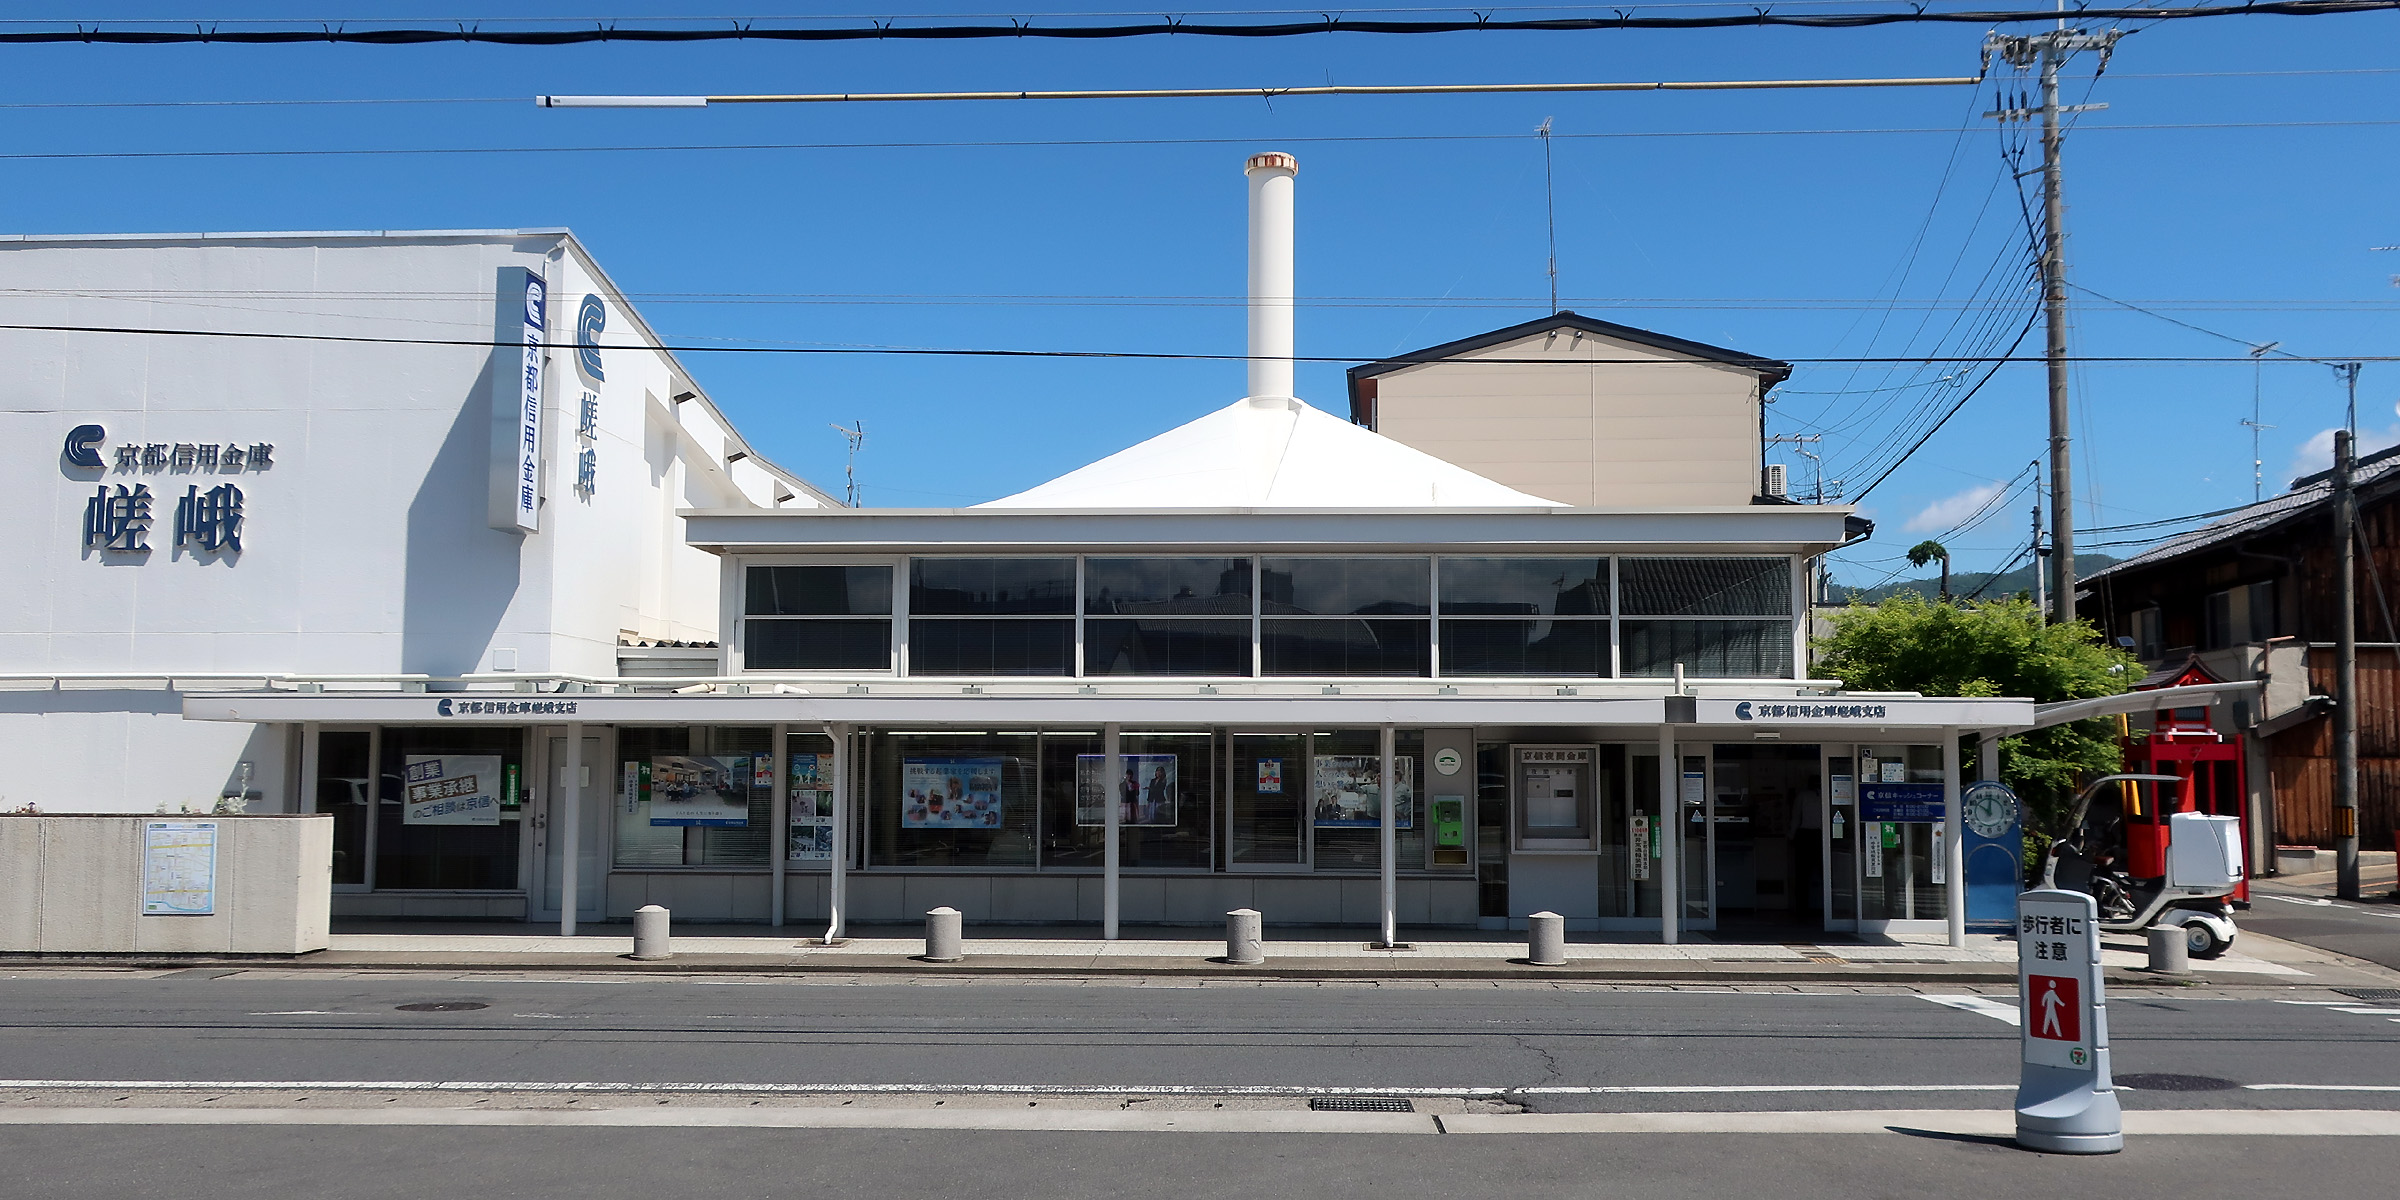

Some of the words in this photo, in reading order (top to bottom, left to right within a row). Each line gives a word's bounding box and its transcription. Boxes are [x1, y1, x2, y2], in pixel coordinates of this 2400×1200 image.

[519, 333, 539, 514] 京都信用金庫
[116, 442, 274, 467] 京都信用金庫
[579, 391, 598, 496] 嵯峨
[86, 483, 247, 551] 嵯峨
[408, 760, 442, 782] 創業
[410, 776, 477, 801] 事業承継
[412, 794, 500, 819] のご相談は京信へ
[2022, 914, 2082, 935] 歩行者に
[2035, 940, 2068, 961] 注意
